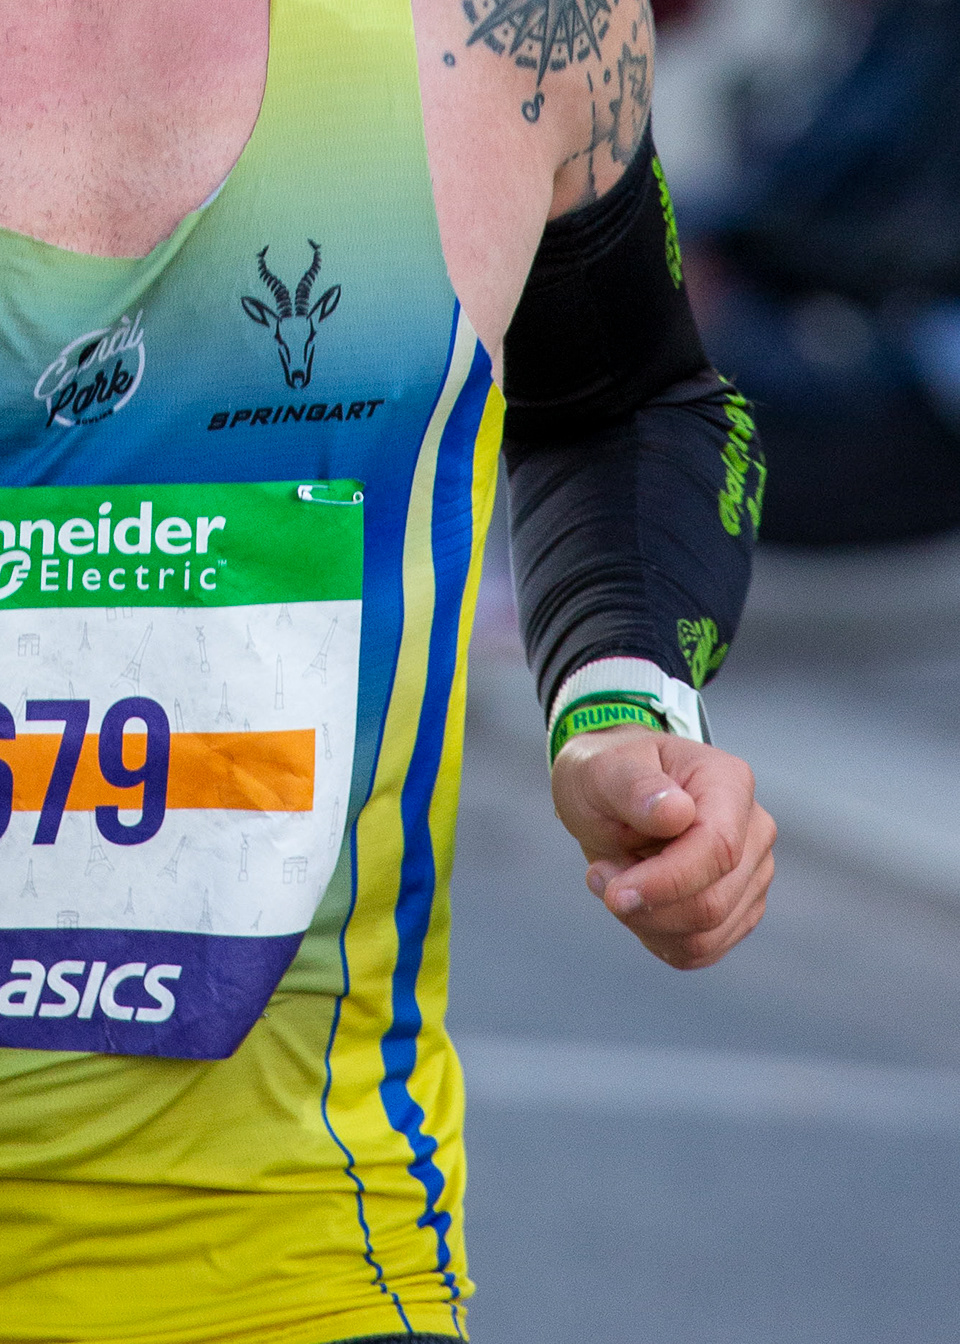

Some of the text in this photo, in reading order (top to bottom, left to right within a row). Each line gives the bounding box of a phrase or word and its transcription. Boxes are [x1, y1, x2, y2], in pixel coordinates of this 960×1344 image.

[45, 359, 134, 429] Park
[206, 397, 385, 432] SPRINGART
[40, 558, 217, 592] Electric
